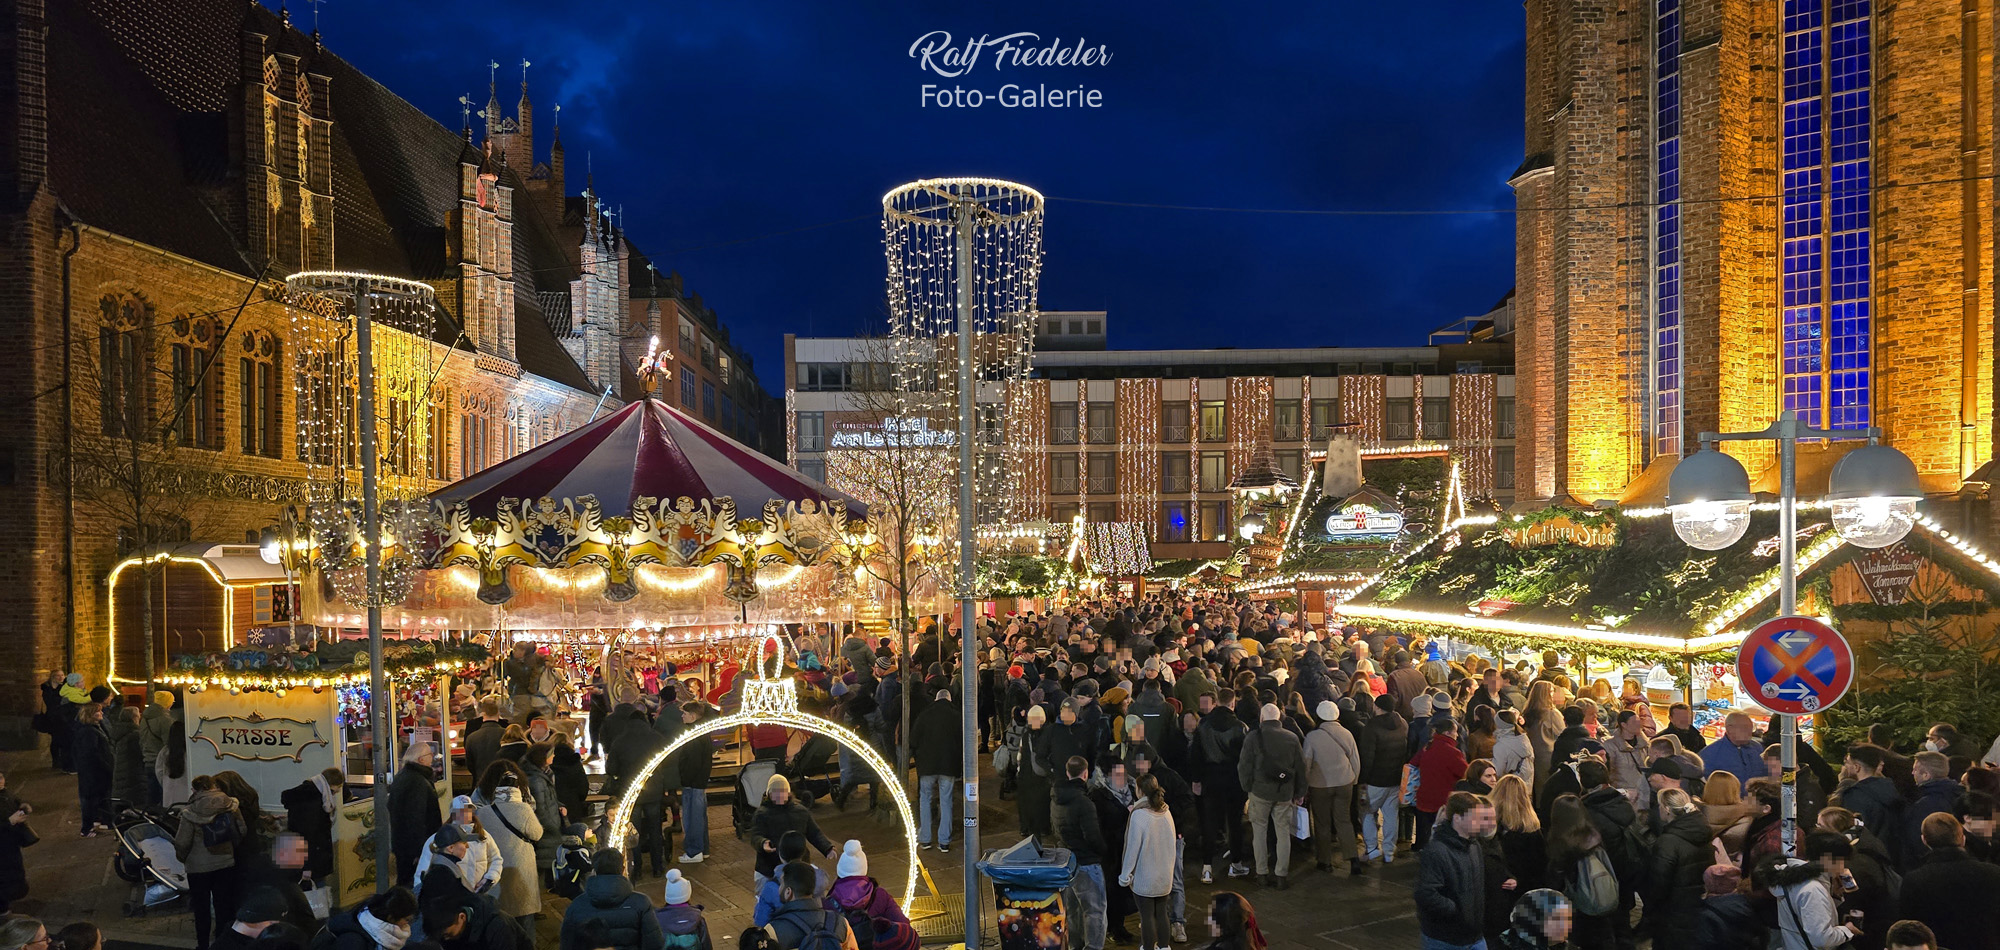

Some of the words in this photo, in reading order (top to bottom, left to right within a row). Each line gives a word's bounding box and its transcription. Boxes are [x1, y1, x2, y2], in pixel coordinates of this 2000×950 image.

[832, 431, 862, 447] Am
[1872, 574, 1912, 588] Hannover
[221, 728, 293, 746] KASSE
